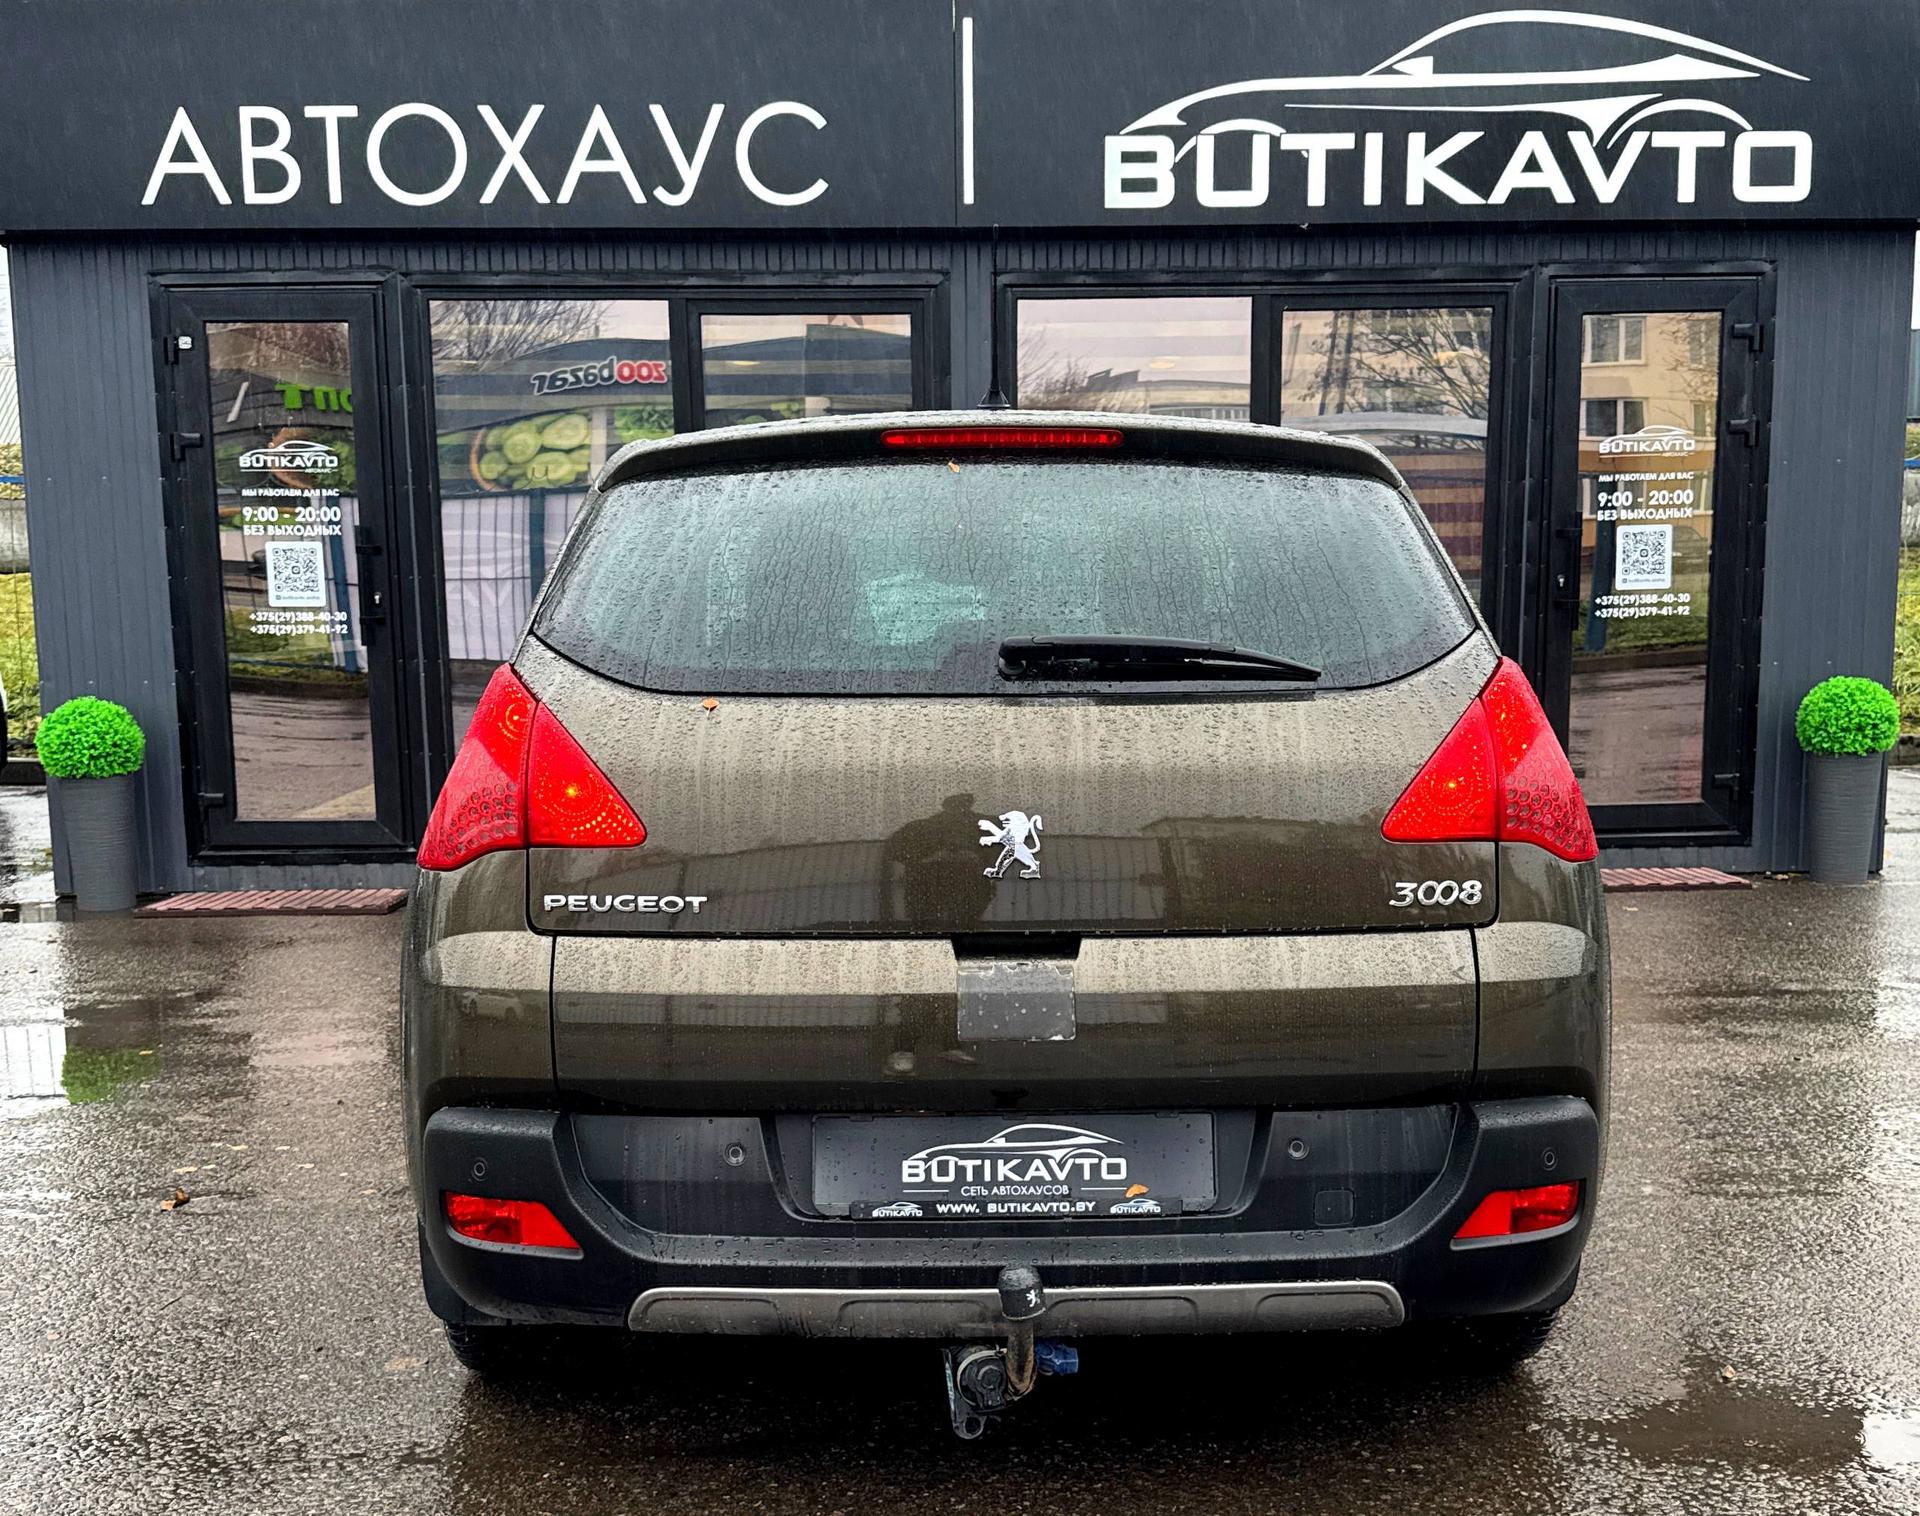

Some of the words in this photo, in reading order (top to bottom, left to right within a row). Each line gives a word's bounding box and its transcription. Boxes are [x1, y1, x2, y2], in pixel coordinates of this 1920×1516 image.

[141, 101, 829, 206] АВТОХАУС
[1103, 130, 1813, 210] BUTIKAVTO
[1599, 440, 1694, 453] BUTIKAVTO
[239, 455, 338, 467] BUTIKAVTO
[1597, 491, 1632, 507] 9:00
[1649, 489, 1694, 505] 20:00
[242, 506, 279, 521] 9:00
[295, 506, 341, 521] 20:00
[1597, 510, 1617, 521] БЕЗ
[1620, 507, 1692, 519] ВЫХОДНЫХ
[243, 525, 264, 536] БЕЗ
[267, 524, 342, 536] ВЫХОДНЫХ
[1388, 879, 1483, 908] 3008
[543, 894, 708, 914] PEUGEOT
[901, 1157, 1127, 1184] BUTIKAVTO
[961, 1186, 988, 1196] СЕТЬ
[991, 1185, 1069, 1196] АВТОХАУСОВ
[872, 1209, 923, 1217] BUTIKAVTO
[936, 1203, 980, 1214] WWW.
[987, 1202, 1096, 1214] BUTIKAVTO.BY
[1110, 1205, 1161, 1214] BUTIKAVTO
